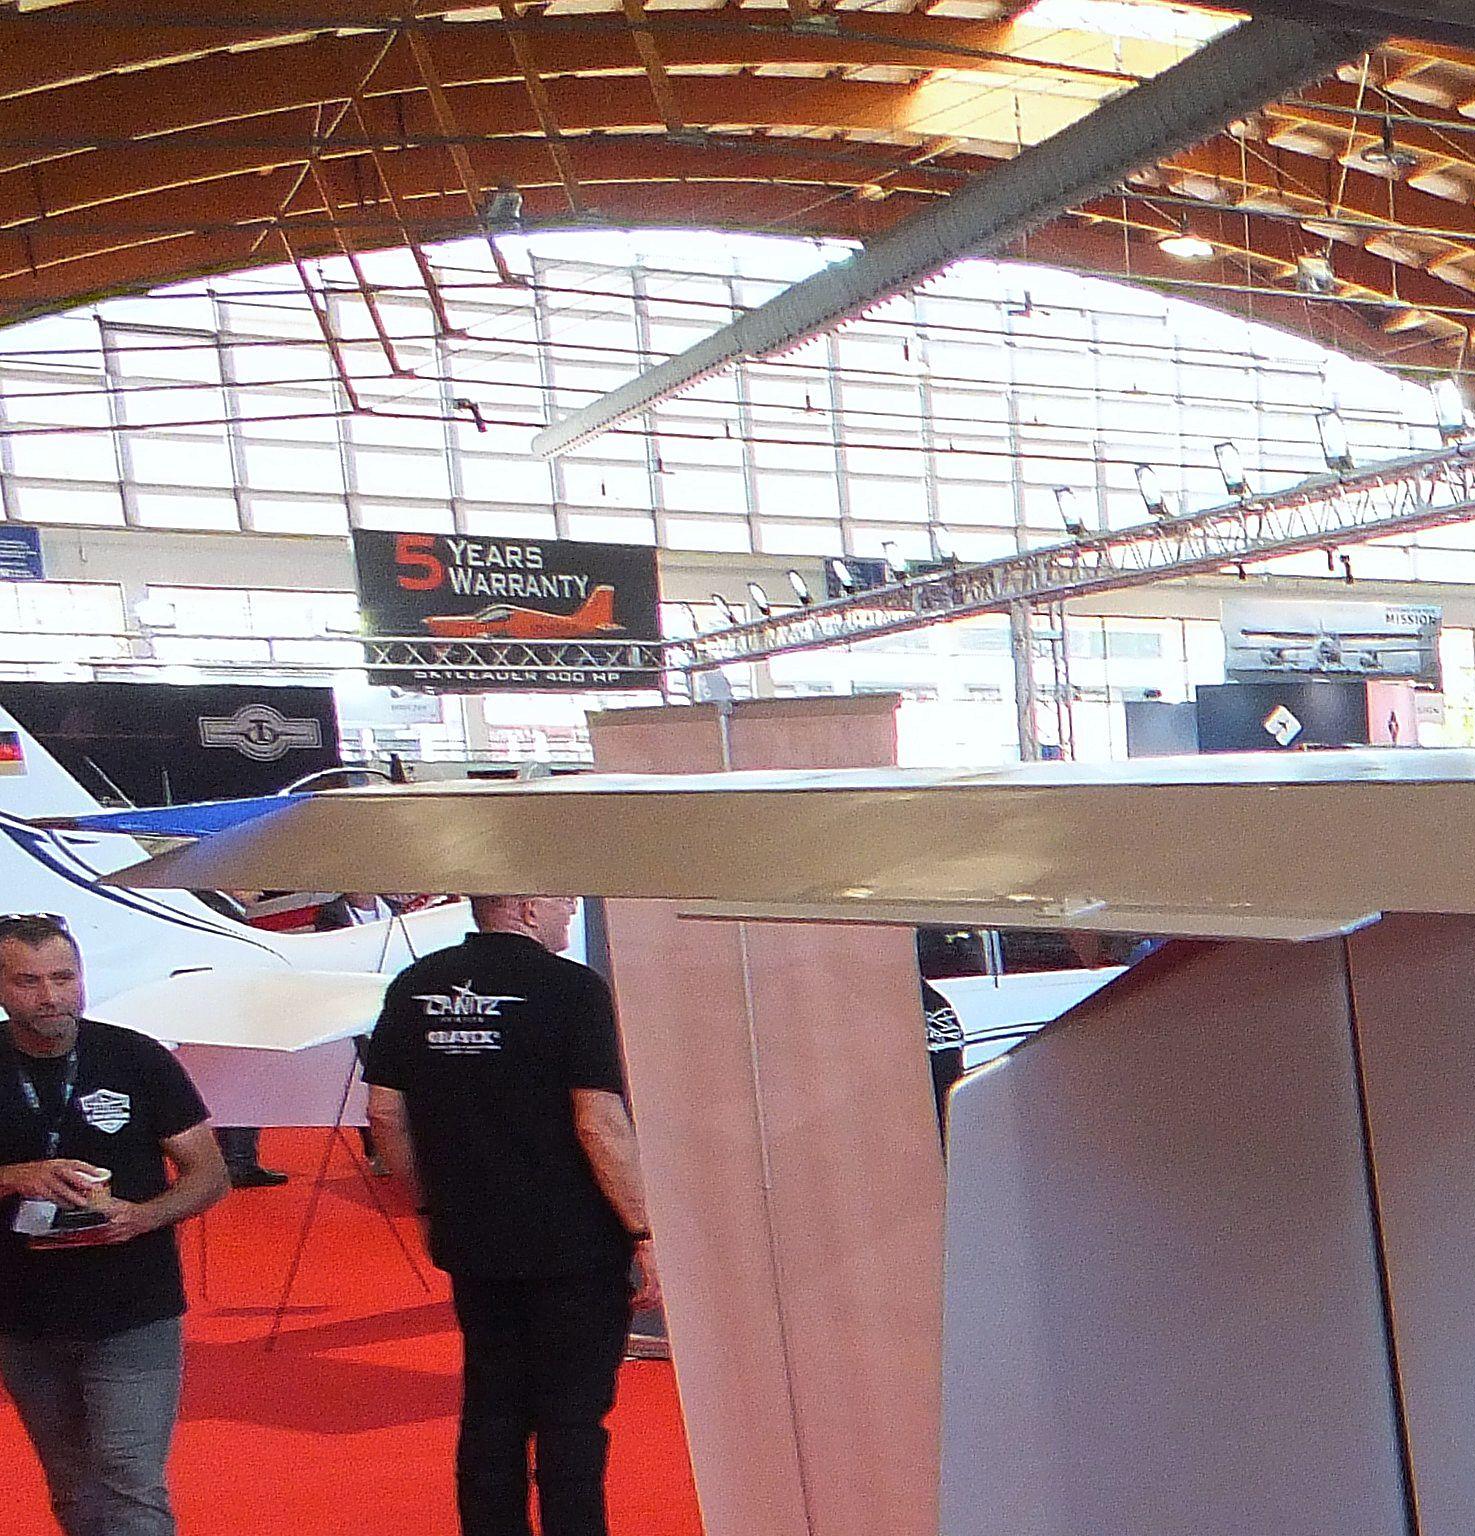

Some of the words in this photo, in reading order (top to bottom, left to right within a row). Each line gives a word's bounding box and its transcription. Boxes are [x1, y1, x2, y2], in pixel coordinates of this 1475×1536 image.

[393, 534, 444, 592] 5
[446, 539, 543, 569] YEARS
[449, 567, 589, 599] WARRANTY
